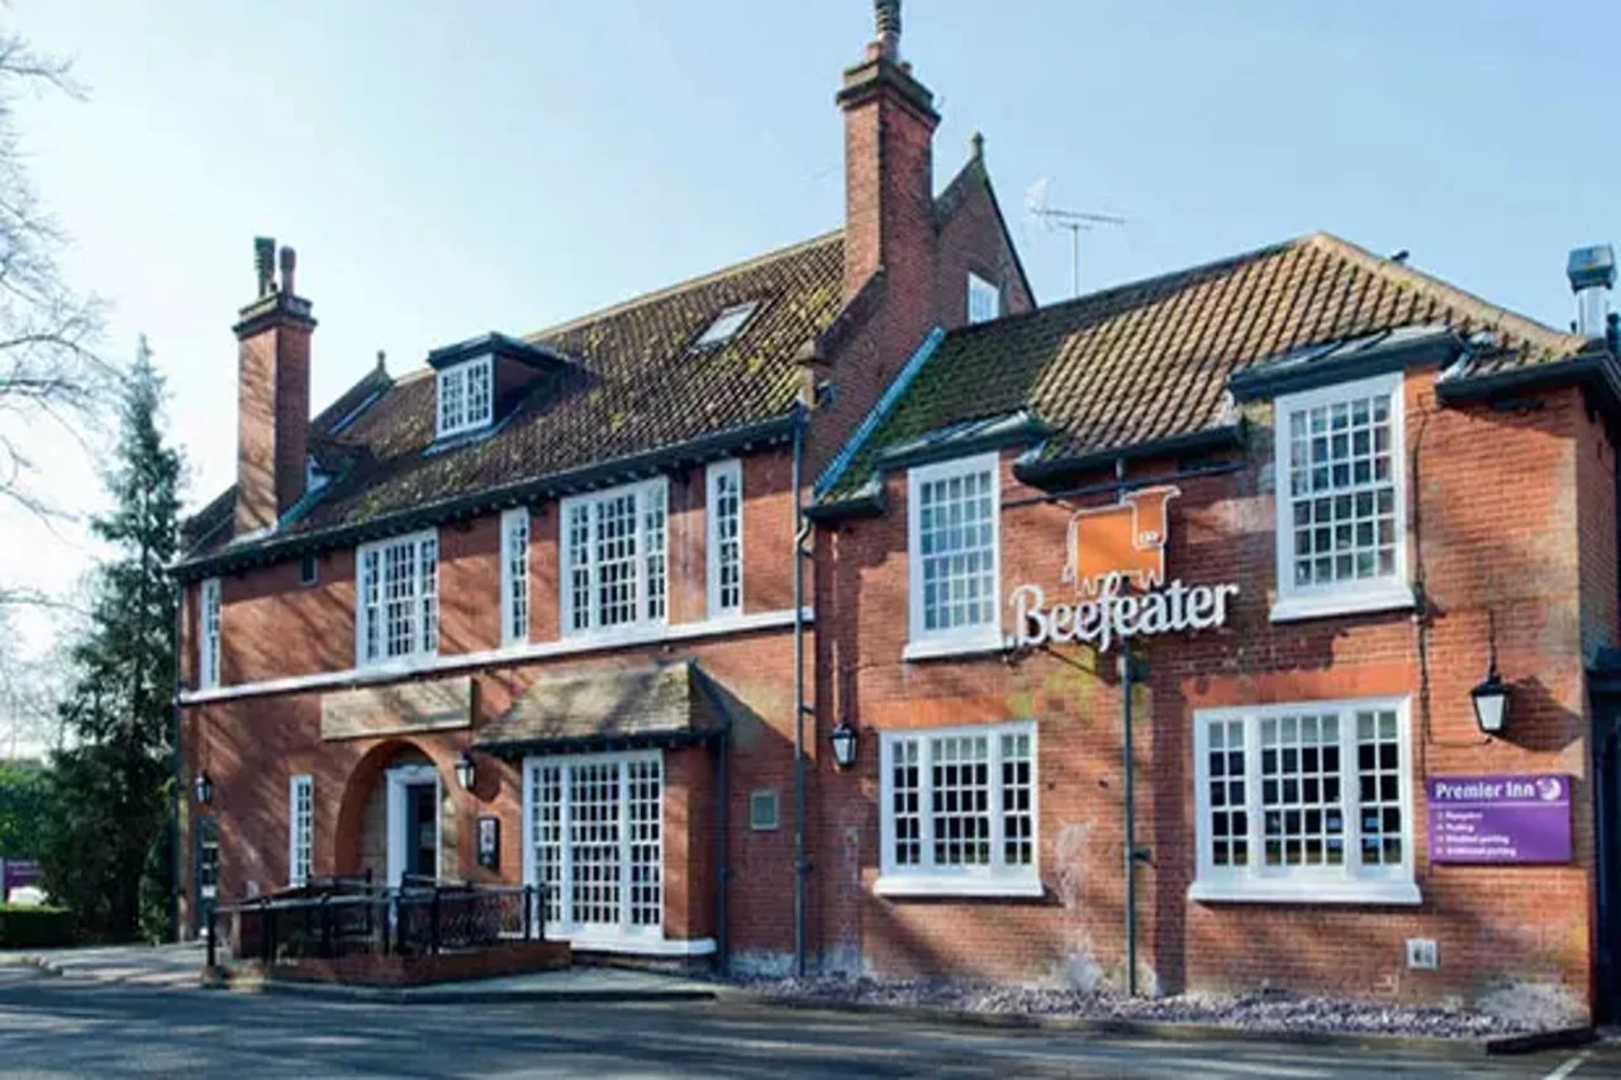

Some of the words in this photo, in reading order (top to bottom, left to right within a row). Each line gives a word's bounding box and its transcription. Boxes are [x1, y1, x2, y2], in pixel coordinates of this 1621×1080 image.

[1009, 572, 1240, 652] Beefeater
[1436, 781, 1503, 799] Premier
[1506, 781, 1536, 797] Inn
